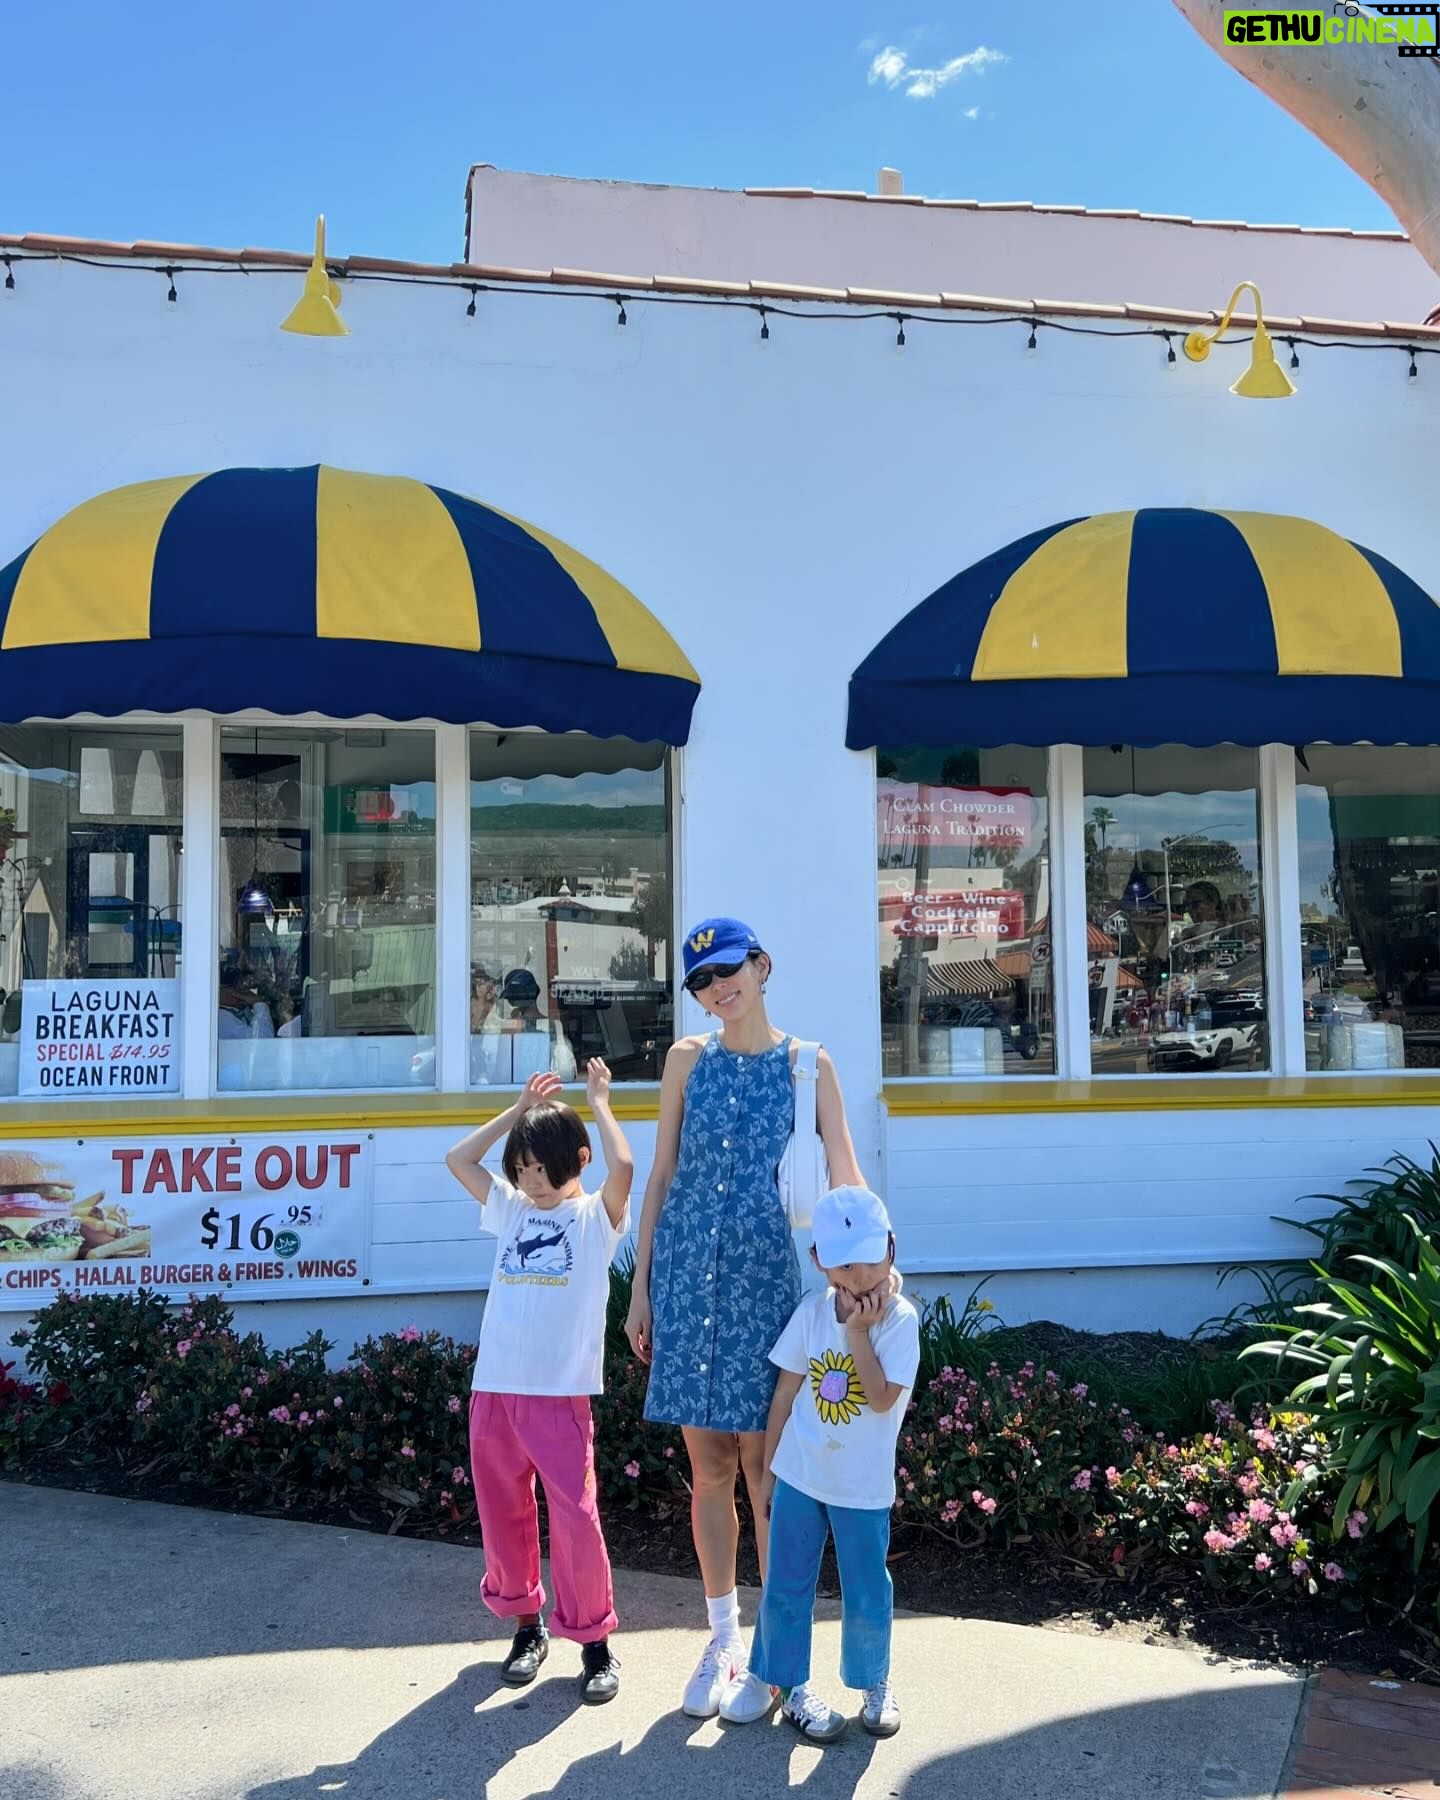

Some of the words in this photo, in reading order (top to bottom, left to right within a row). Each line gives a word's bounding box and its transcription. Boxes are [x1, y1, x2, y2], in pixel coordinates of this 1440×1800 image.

[901, 892, 942, 904] Beer
[961, 892, 1006, 905] Wine
[911, 905, 999, 919] Cocktails
[900, 919, 1009, 934] Cappuccino
[690, 928, 715, 953] W
[51, 990, 160, 1012] LAGUNA
[36, 1013, 174, 1040] BREAKFAST
[36, 1043, 104, 1062] SPECIAL
[109, 1043, 172, 1060] $14.95
[40, 1066, 103, 1087] OCEAN
[109, 1065, 171, 1086] FRONT
[112, 1146, 242, 1194] TAKE
[254, 1144, 361, 1191] OUT
[6, 1268, 61, 1289] CHIPS
[75, 1265, 136, 1287] HALAL
[140, 1263, 214, 1285] BURGER
[217, 1262, 232, 1282] &
[235, 1262, 284, 1281] FRIES
[297, 1259, 357, 1279] WINGS
